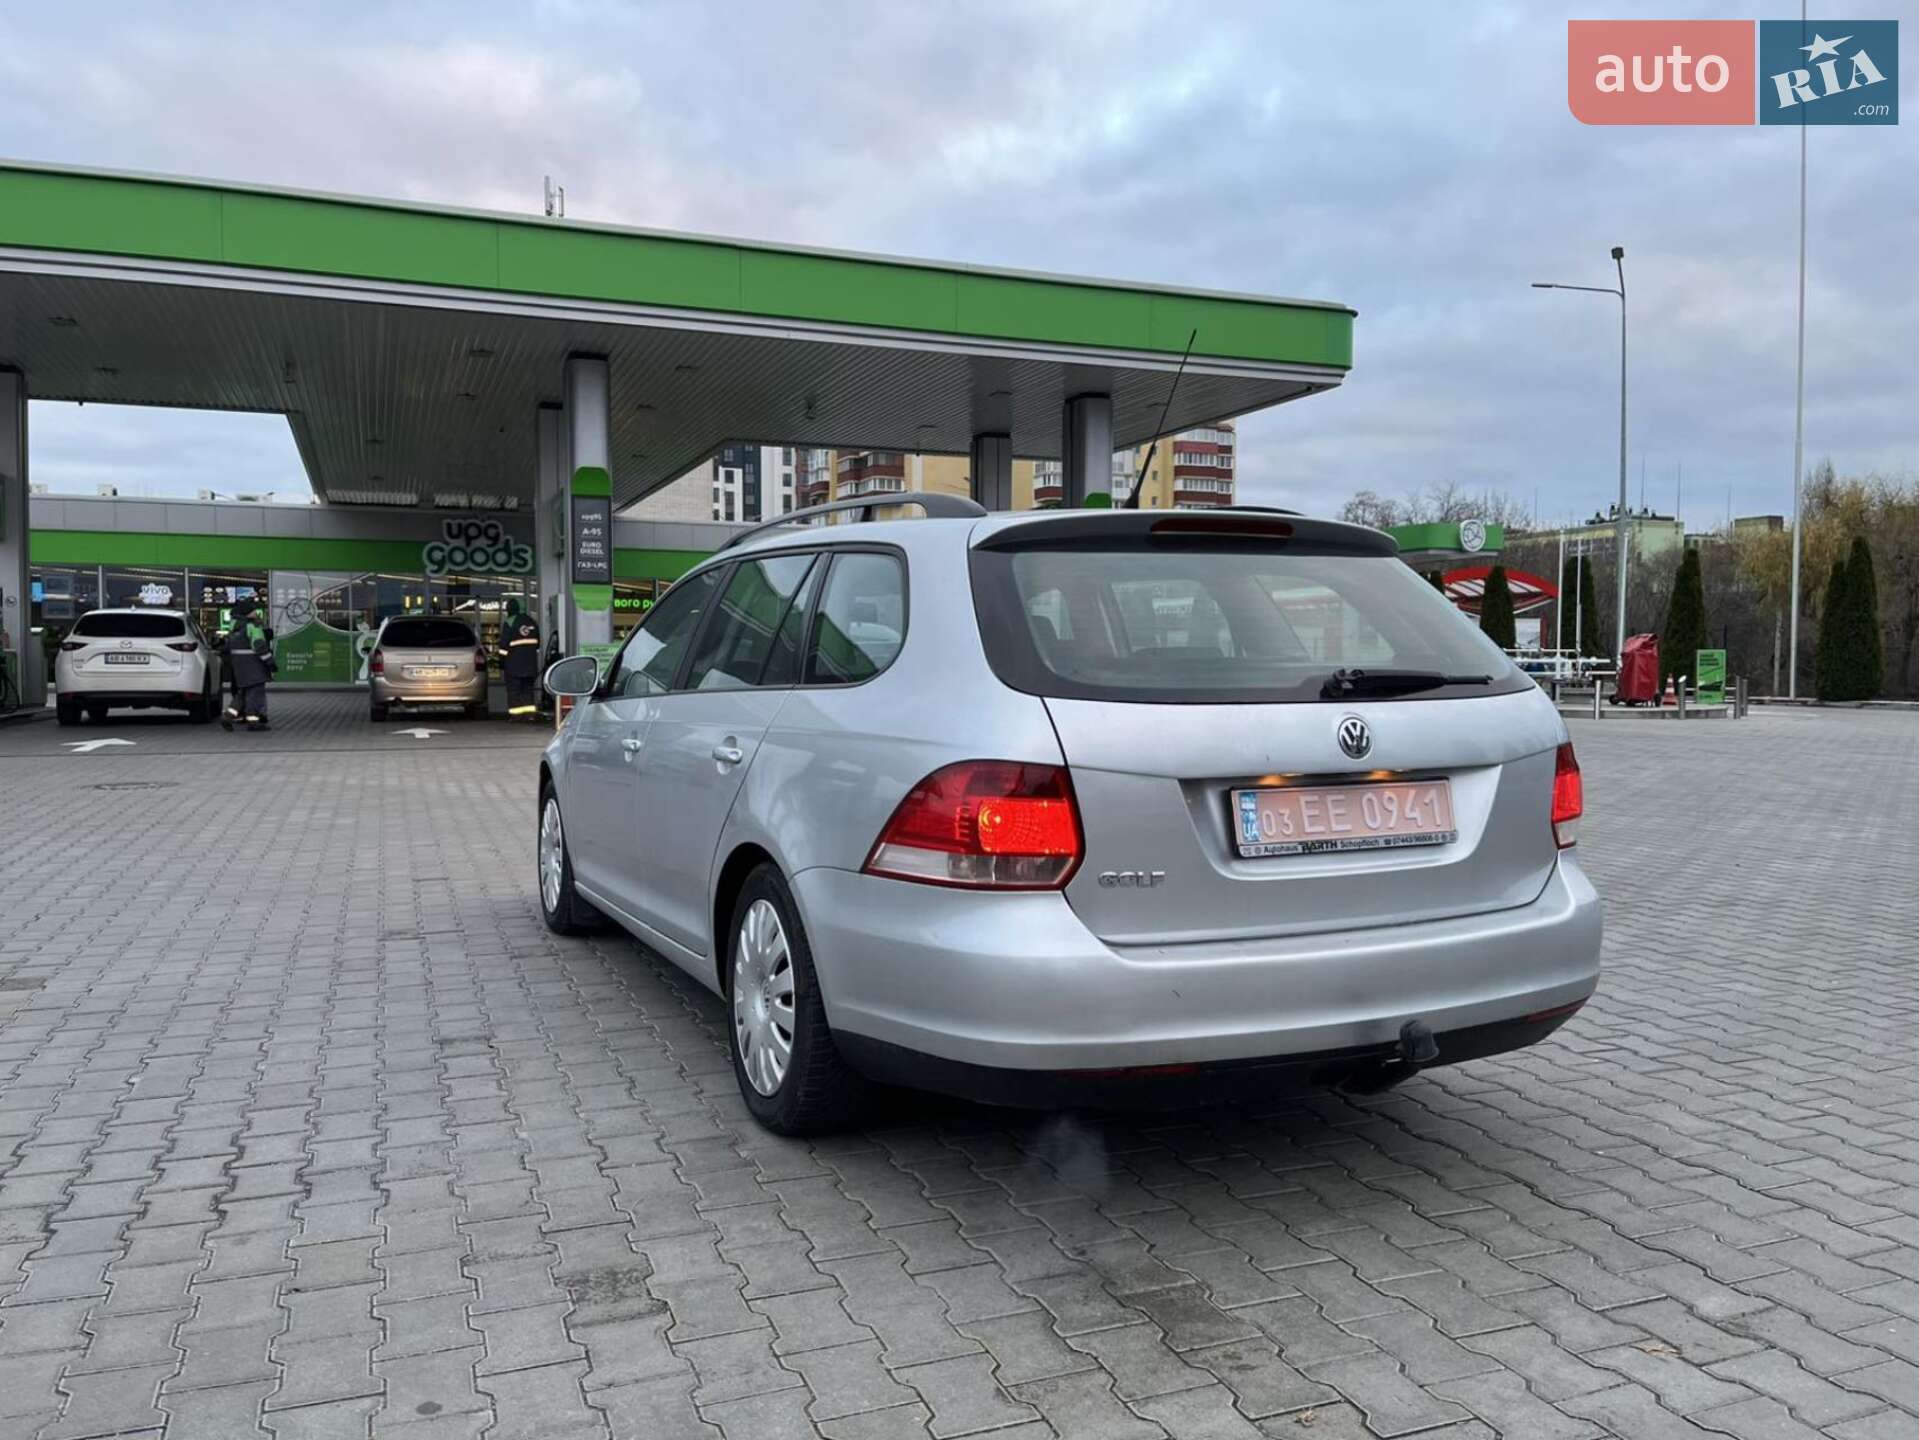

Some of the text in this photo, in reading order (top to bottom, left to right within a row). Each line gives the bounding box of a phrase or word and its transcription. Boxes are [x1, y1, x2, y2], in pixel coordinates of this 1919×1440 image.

[445, 521, 502, 548] upg
[425, 538, 531, 574] goods
[1261, 789, 1443, 837] 03 EE 0941
[1098, 871, 1166, 888] GOLF
